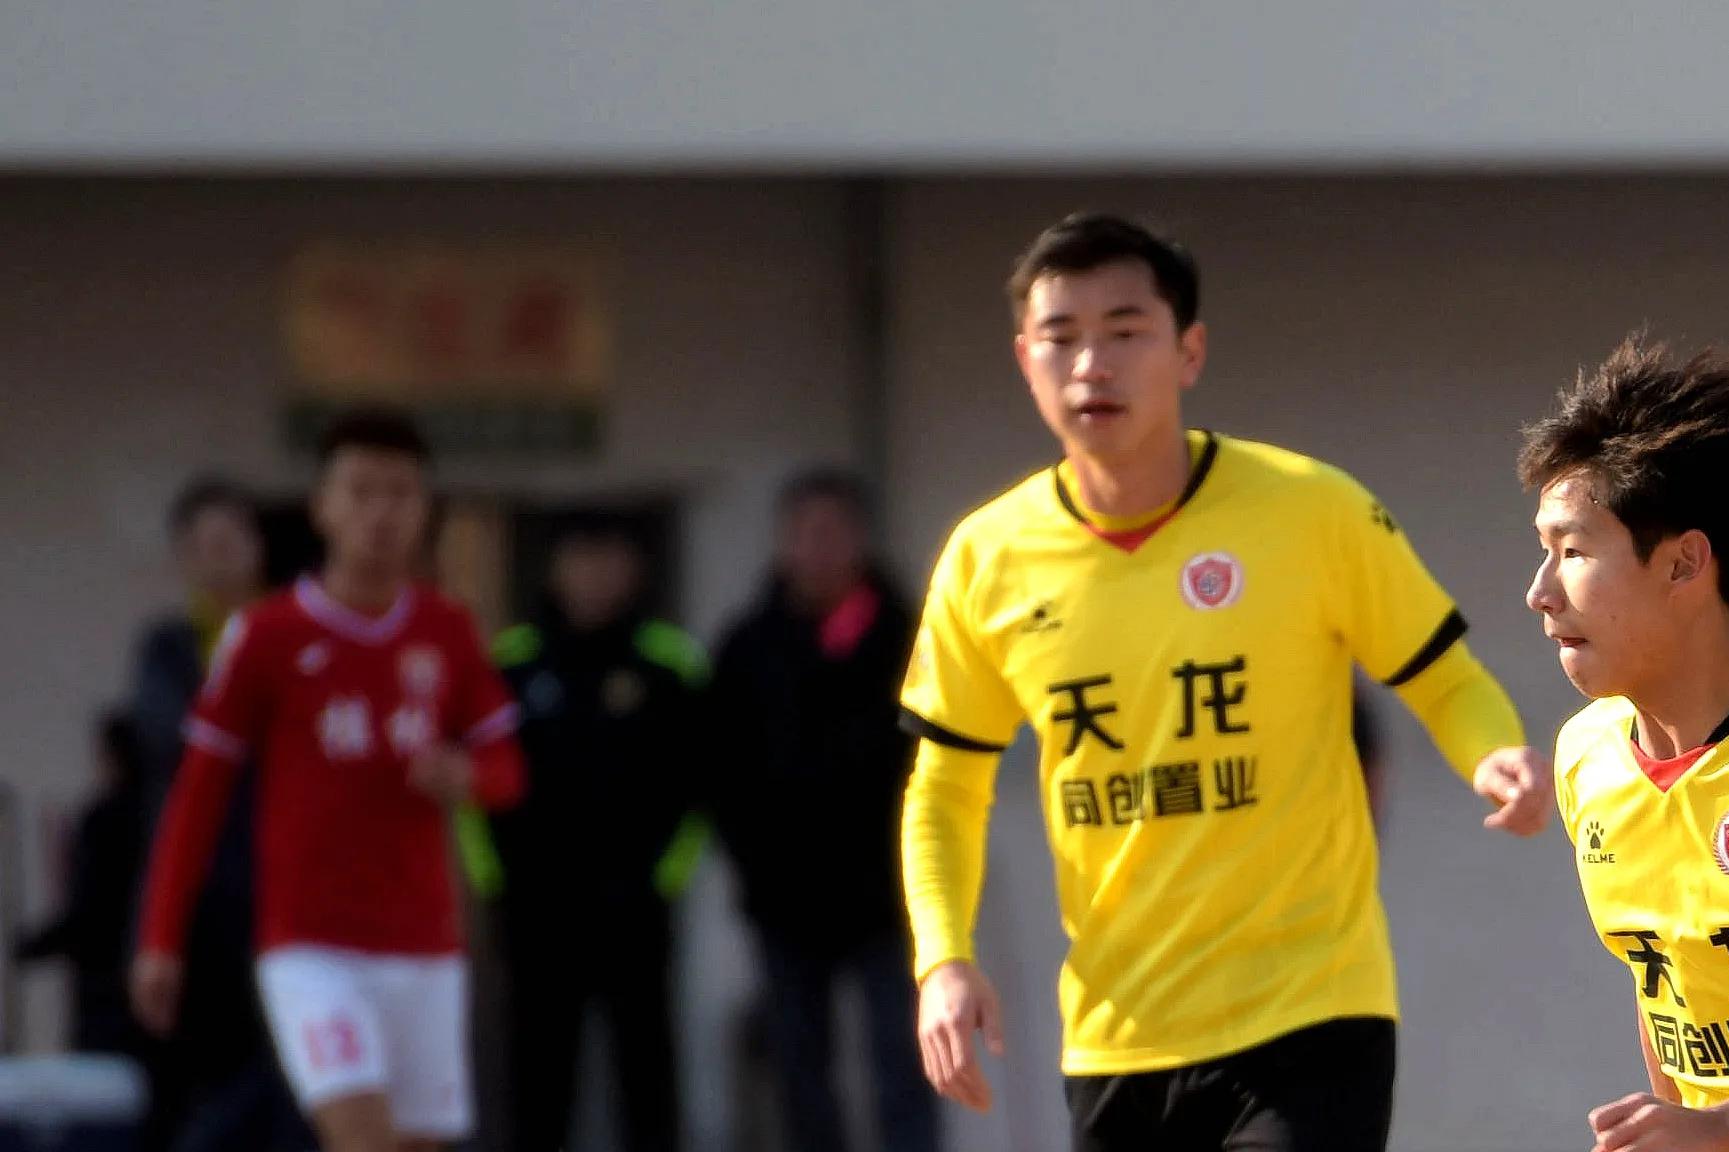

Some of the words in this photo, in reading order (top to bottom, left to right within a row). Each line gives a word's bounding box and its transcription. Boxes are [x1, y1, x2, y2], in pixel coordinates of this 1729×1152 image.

[1047, 655, 1252, 755] 天龙
[1060, 756, 1261, 829] 同创置业
